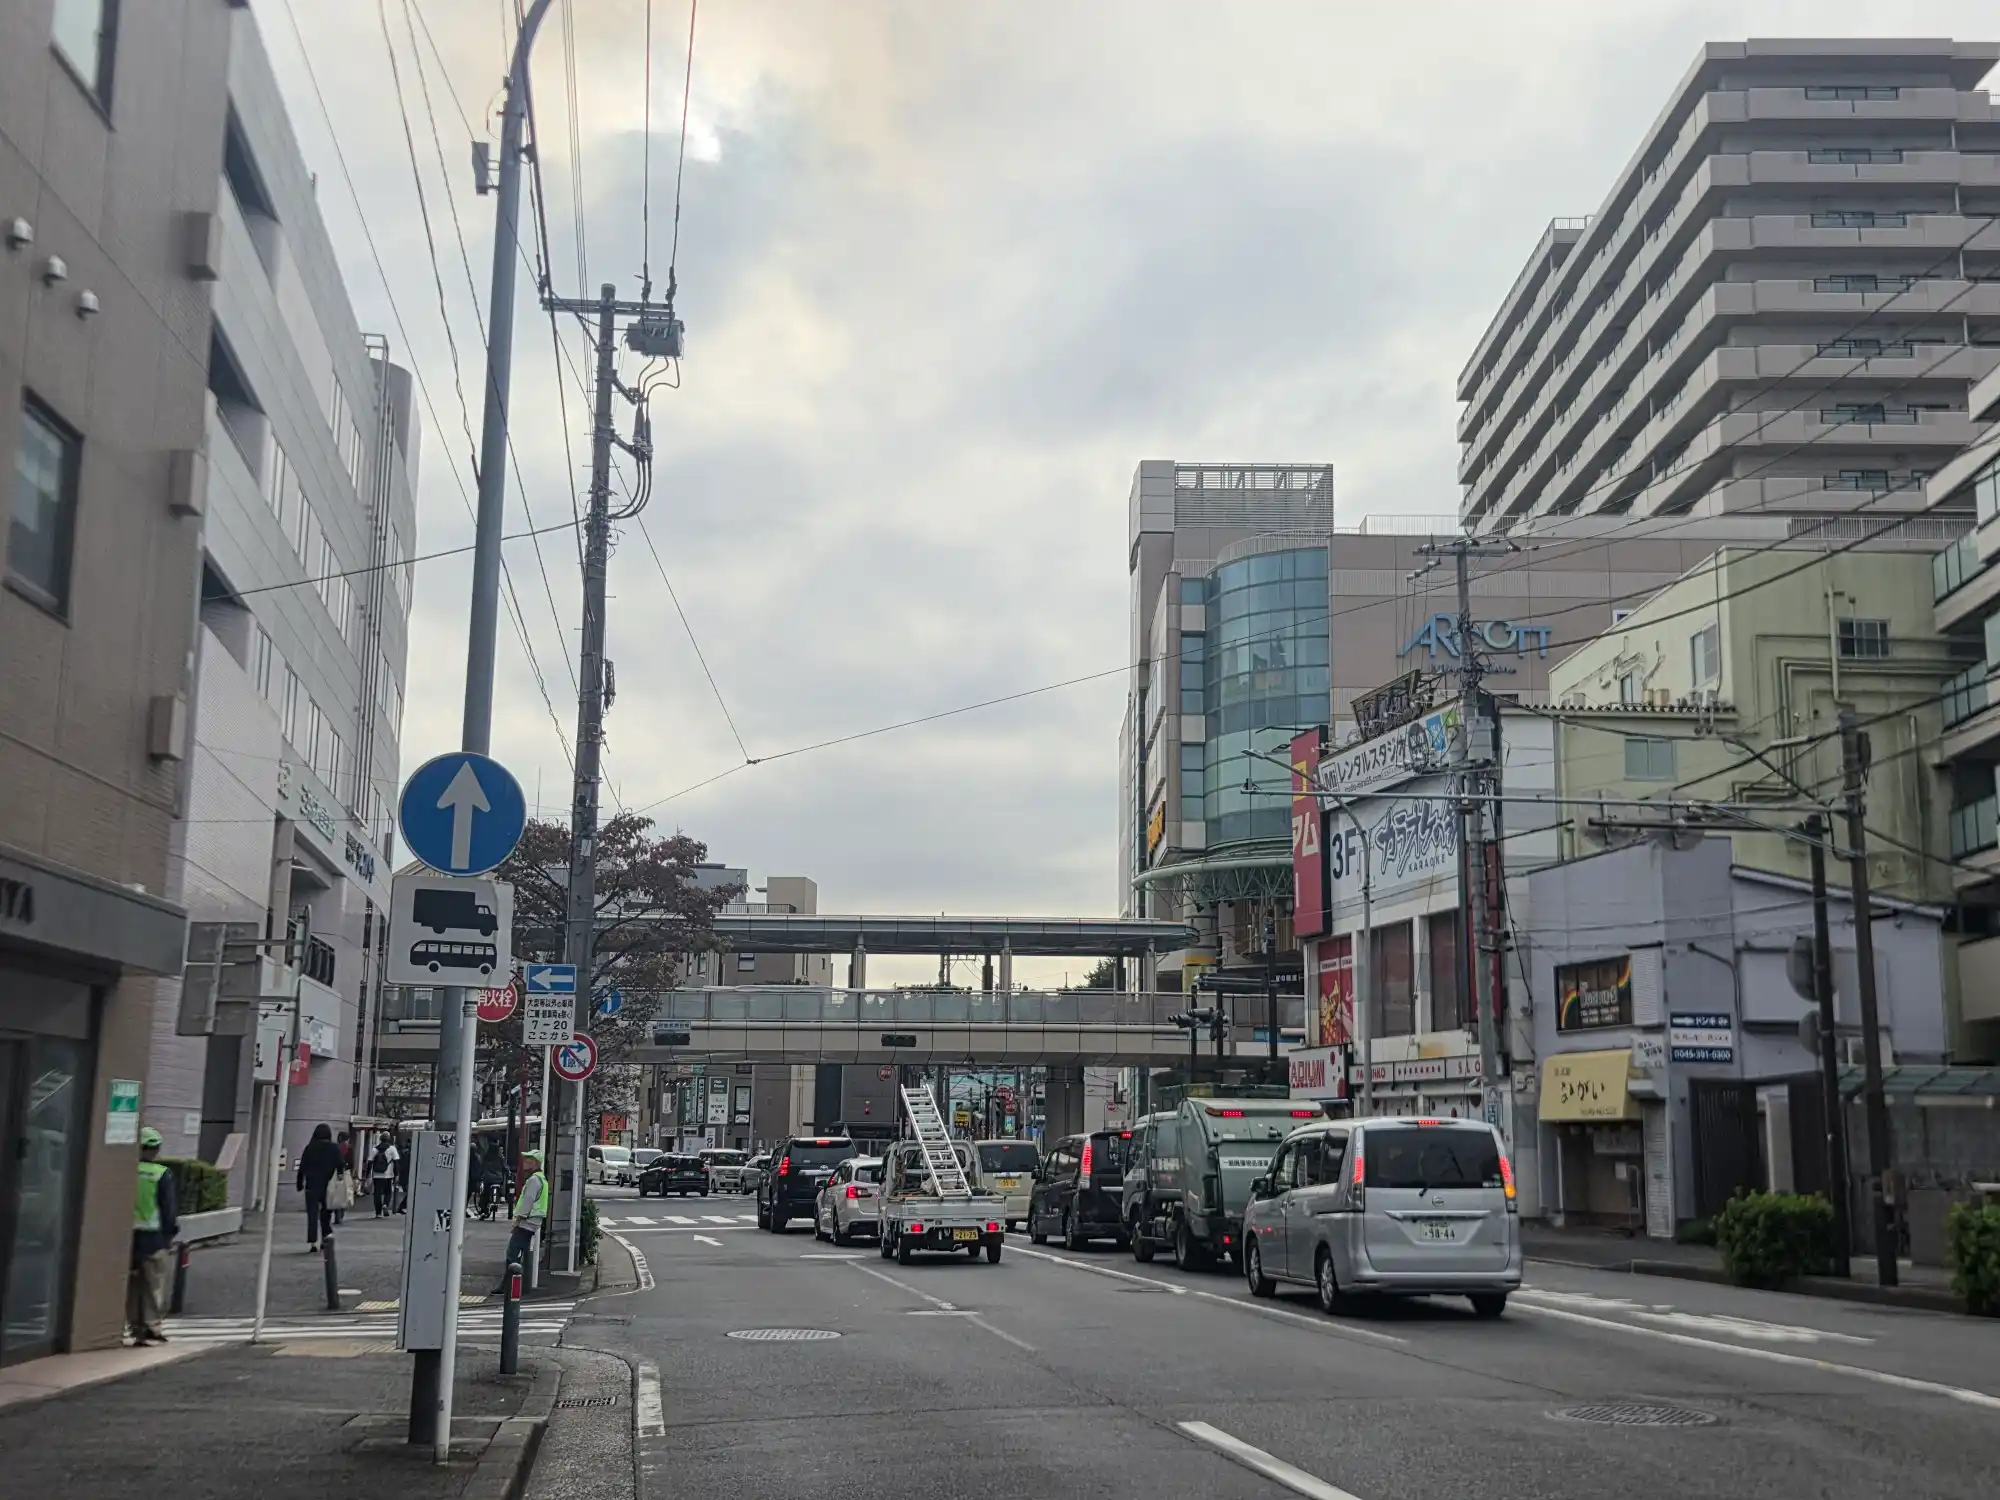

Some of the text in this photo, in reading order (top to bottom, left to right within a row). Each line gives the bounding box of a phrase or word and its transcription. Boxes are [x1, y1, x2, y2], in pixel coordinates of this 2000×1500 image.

[1332, 828, 1357, 880] 3F
[1408, 855, 1446, 873] KARAOKE
[477, 989, 513, 1008] 消火栓
[528, 1032, 570, 1040] ここから
